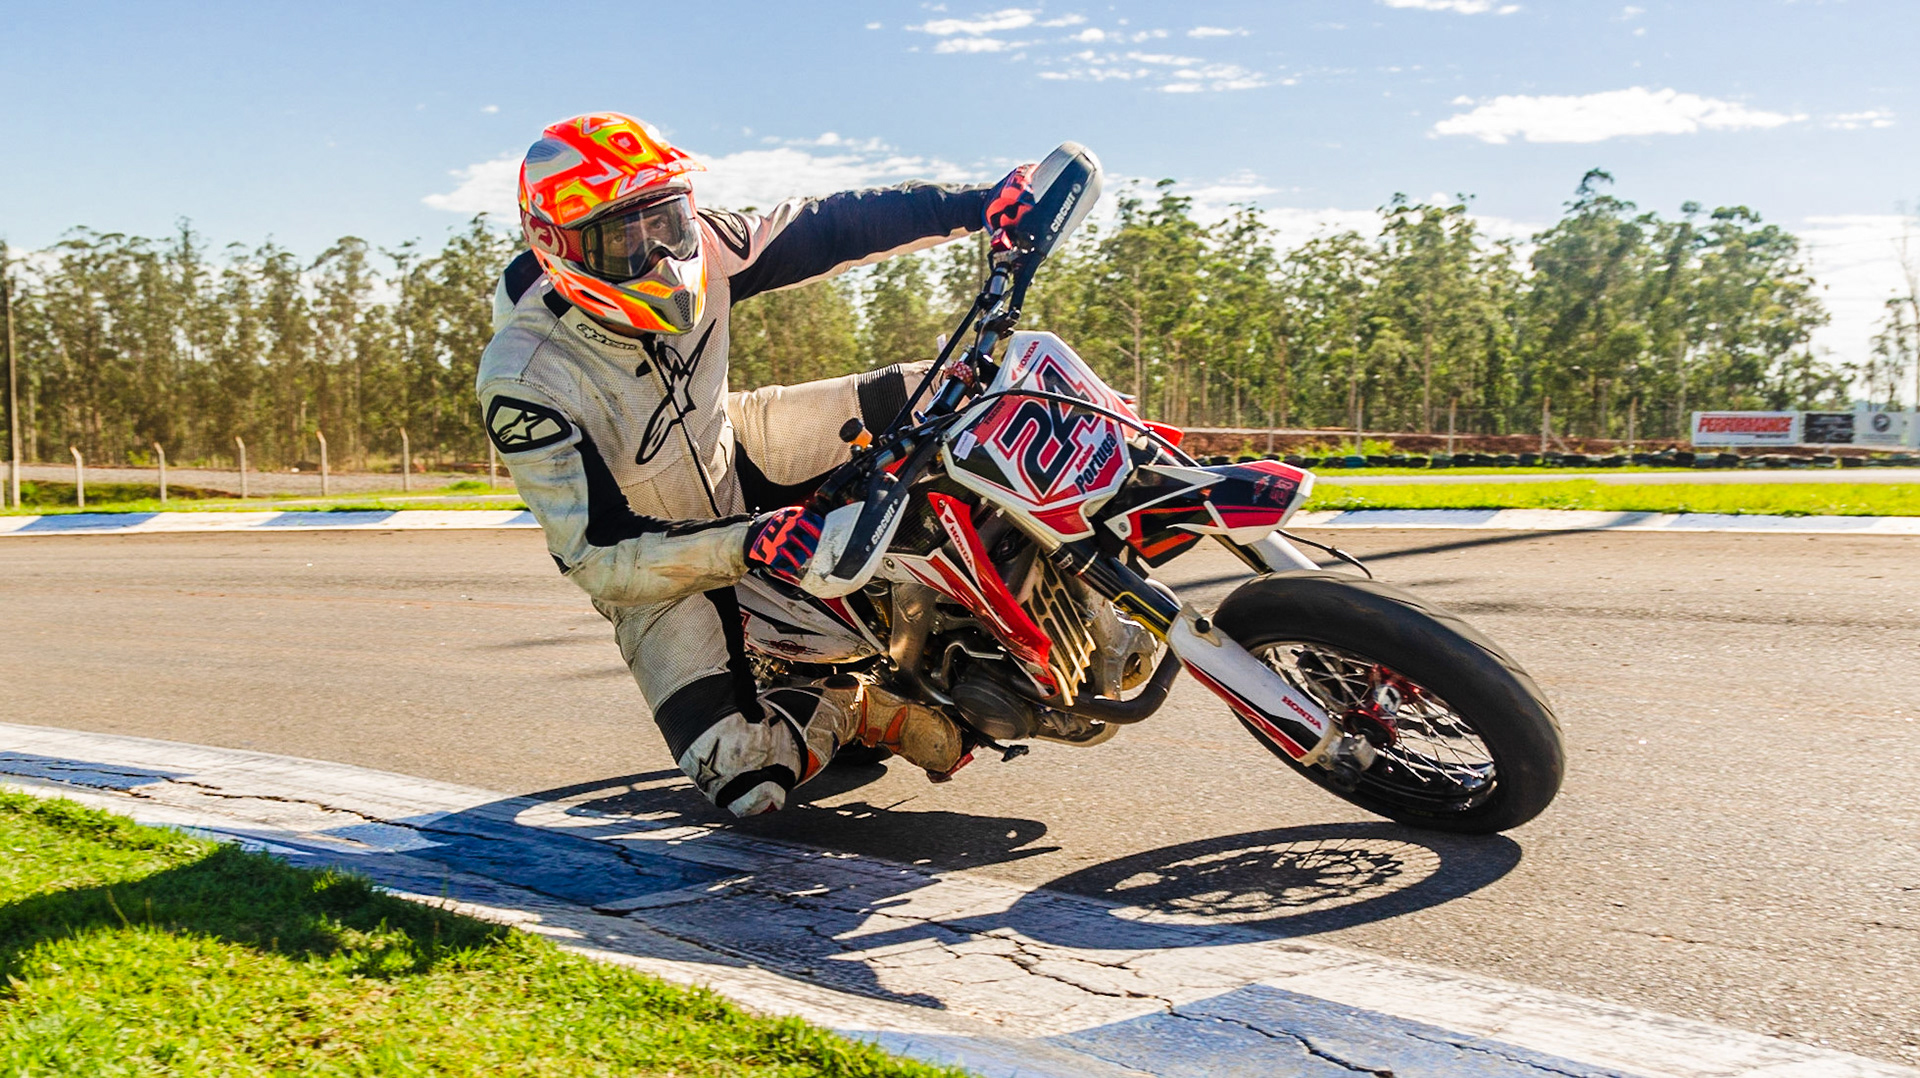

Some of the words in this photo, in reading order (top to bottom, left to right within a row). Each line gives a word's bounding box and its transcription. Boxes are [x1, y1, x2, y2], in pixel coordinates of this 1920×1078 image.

[1050, 192, 1076, 233] CIRCUIT
[1017, 341, 1039, 372] HONDA
[1000, 362, 1097, 496] 24
[1074, 432, 1117, 495] Portuga
[871, 504, 895, 545] CIRCUIT
[950, 526, 973, 568] HONDA
[1282, 696, 1322, 730] HONDA
